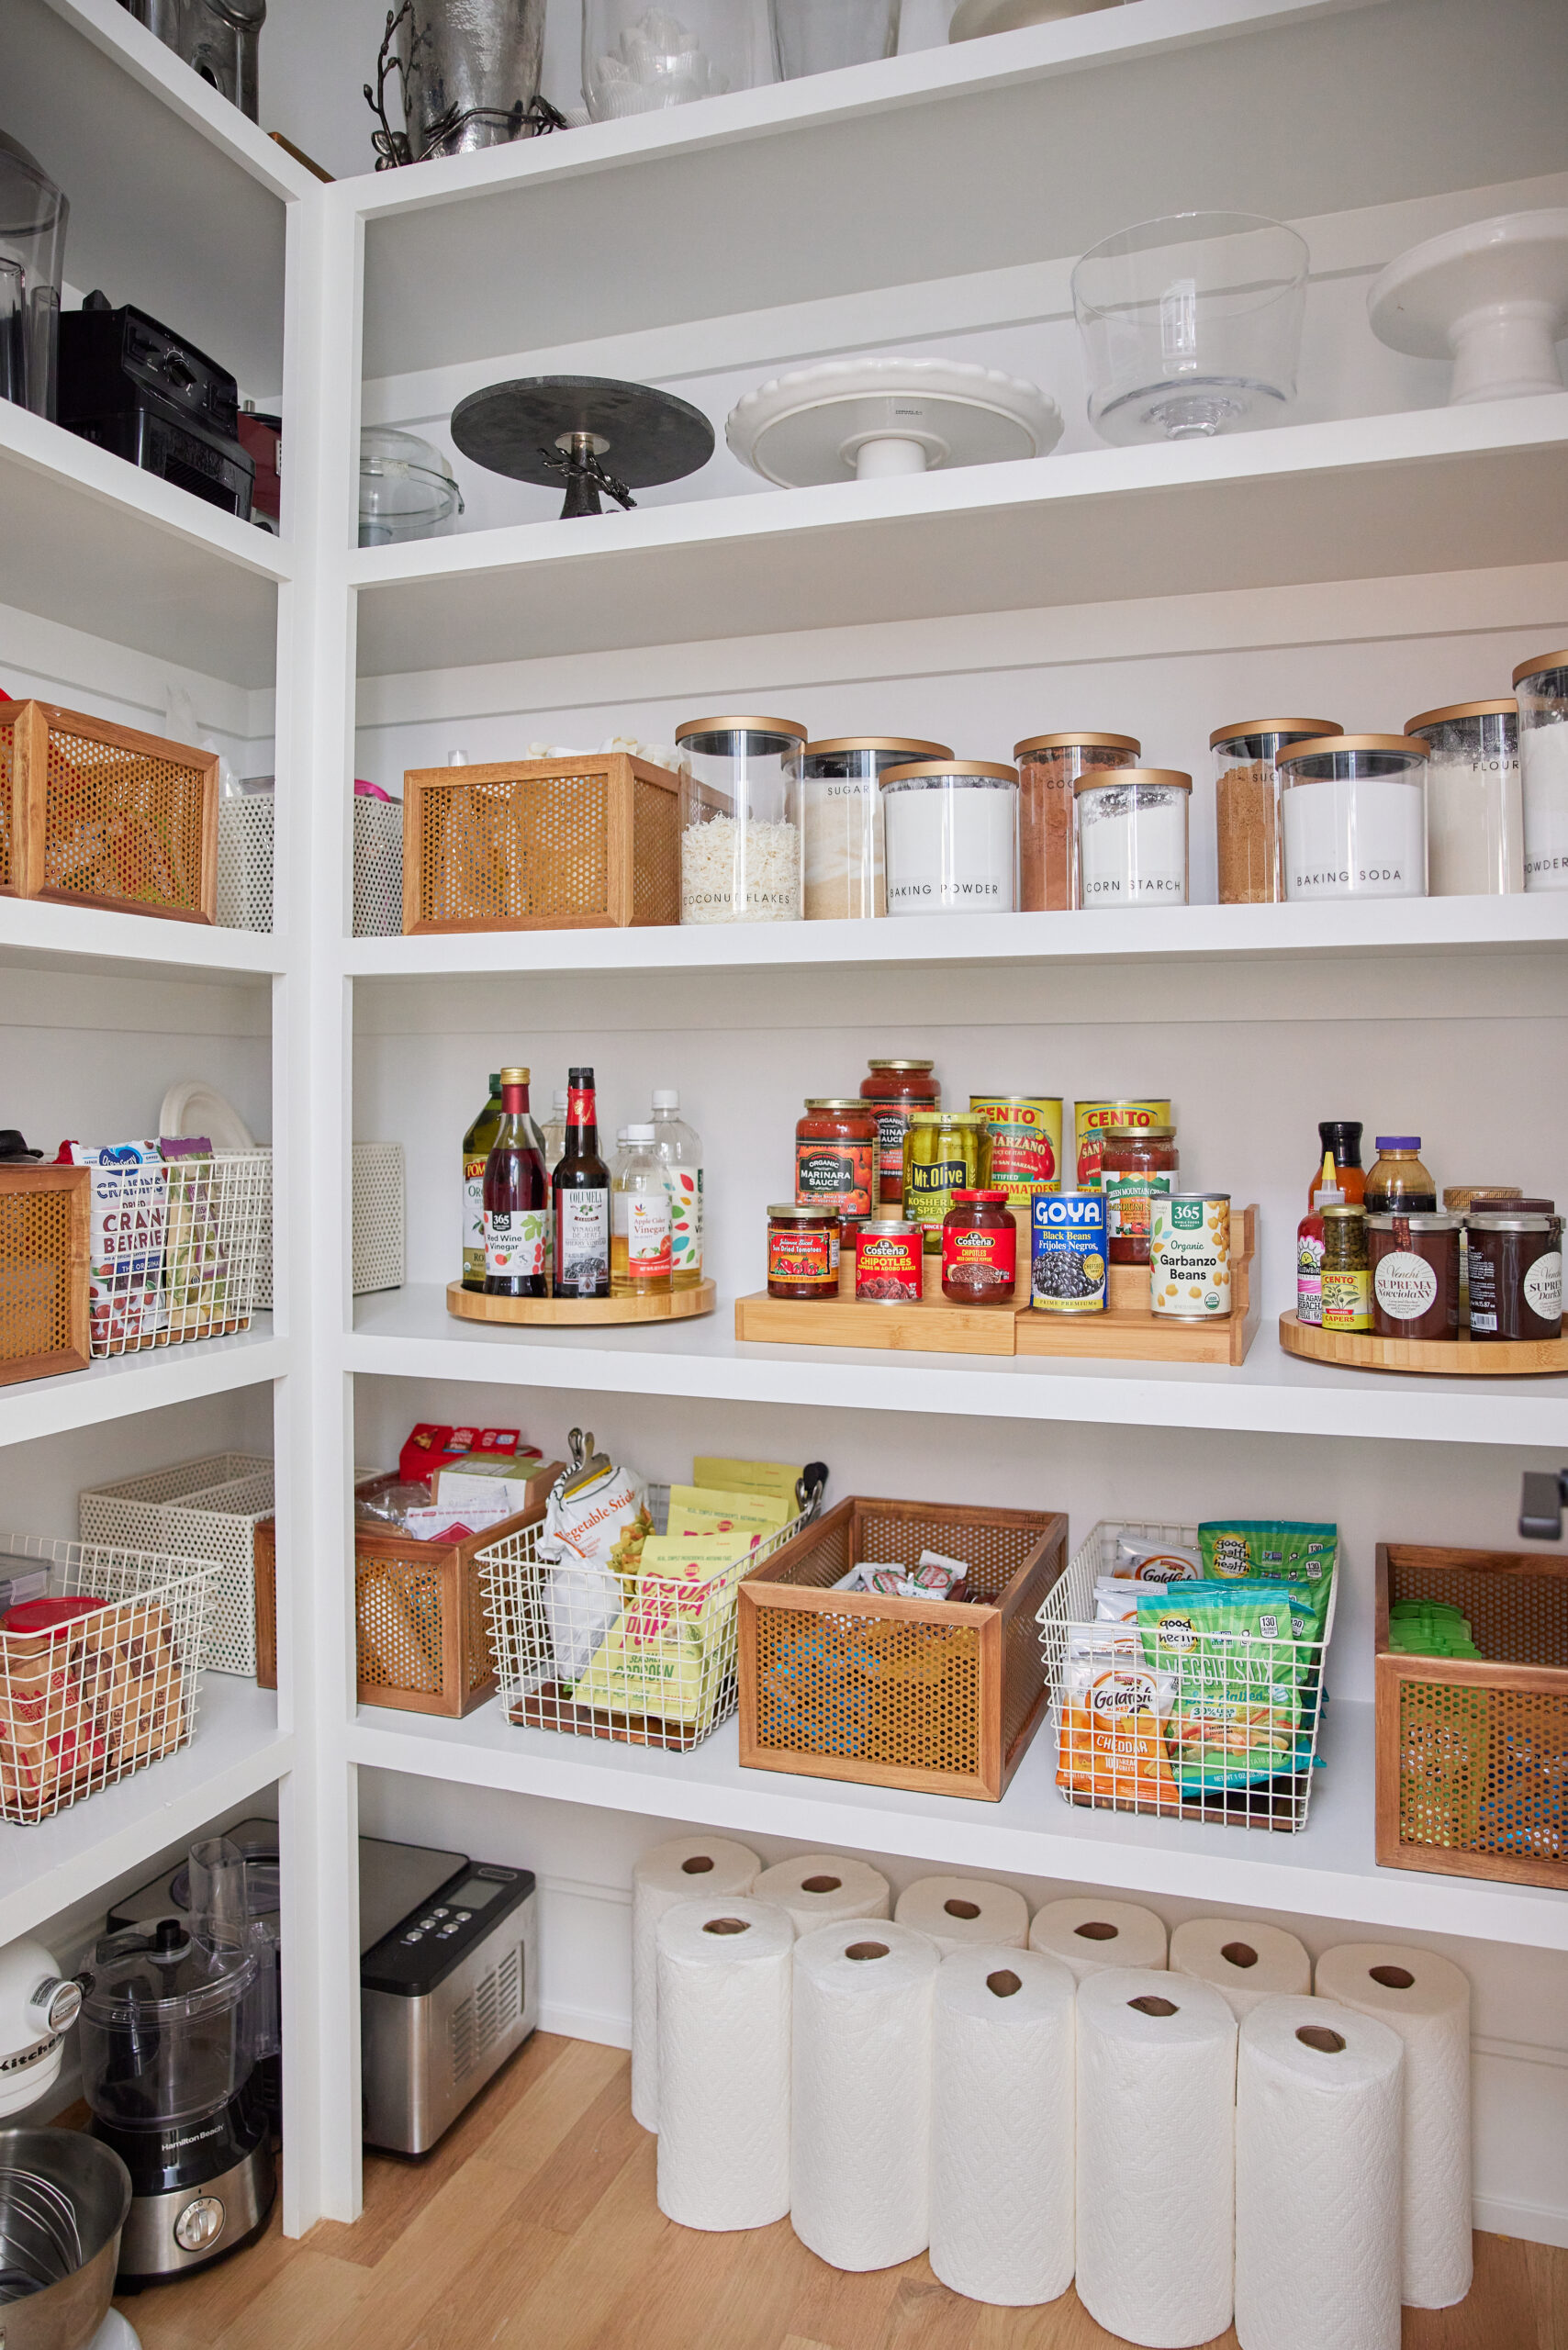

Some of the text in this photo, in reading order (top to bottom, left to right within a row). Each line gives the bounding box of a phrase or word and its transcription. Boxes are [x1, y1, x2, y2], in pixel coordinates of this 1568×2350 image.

[1473, 760, 1519, 772] FLOUR
[827, 785, 869, 796] SUGAR
[1296, 869, 1402, 887] BAKING SODA
[890, 884, 999, 899] BAKING POWDER
[1087, 879, 1181, 893] CORN STARCH
[683, 894, 790, 906] COCONUT FLAKES
[1088, 1111, 1150, 1127] CENTO
[809, 1159, 840, 1169] ORGANIC
[801, 1169, 851, 1180] MARINARA
[914, 1166, 963, 1189] Mt. Olive
[809, 1179, 839, 1187] SAUCE
[569, 1190, 603, 1203] COLUMELA
[908, 1197, 948, 1207] KOSHER
[1036, 1202, 1100, 1225] GOYA
[1174, 1205, 1200, 1220] 365
[493, 1214, 510, 1225] 365
[634, 1225, 666, 1236] Vinegar
[1043, 1231, 1091, 1240] Black Beans
[499, 1234, 522, 1242] Wine
[489, 1242, 520, 1252] Vinegar
[866, 1246, 904, 1255] Costeña
[1038, 1240, 1096, 1251] Frijoles Negros
[1170, 1240, 1204, 1252] Organic
[860, 1257, 912, 1267] CHIPOTLES
[1160, 1255, 1217, 1267] Garbanzo
[1170, 1269, 1207, 1281] Beans
[1386, 1264, 1420, 1279] Venchi
[1325, 1275, 1354, 1284] CENTO
[1377, 1280, 1431, 1290] SUPREMA
[1326, 1315, 1355, 1323] CAPERS
[1261, 1617, 1275, 1627] 130
[1096, 1735, 1148, 1754] CHEDDAR
[162, 2125, 223, 2152] Hamilton Beach
